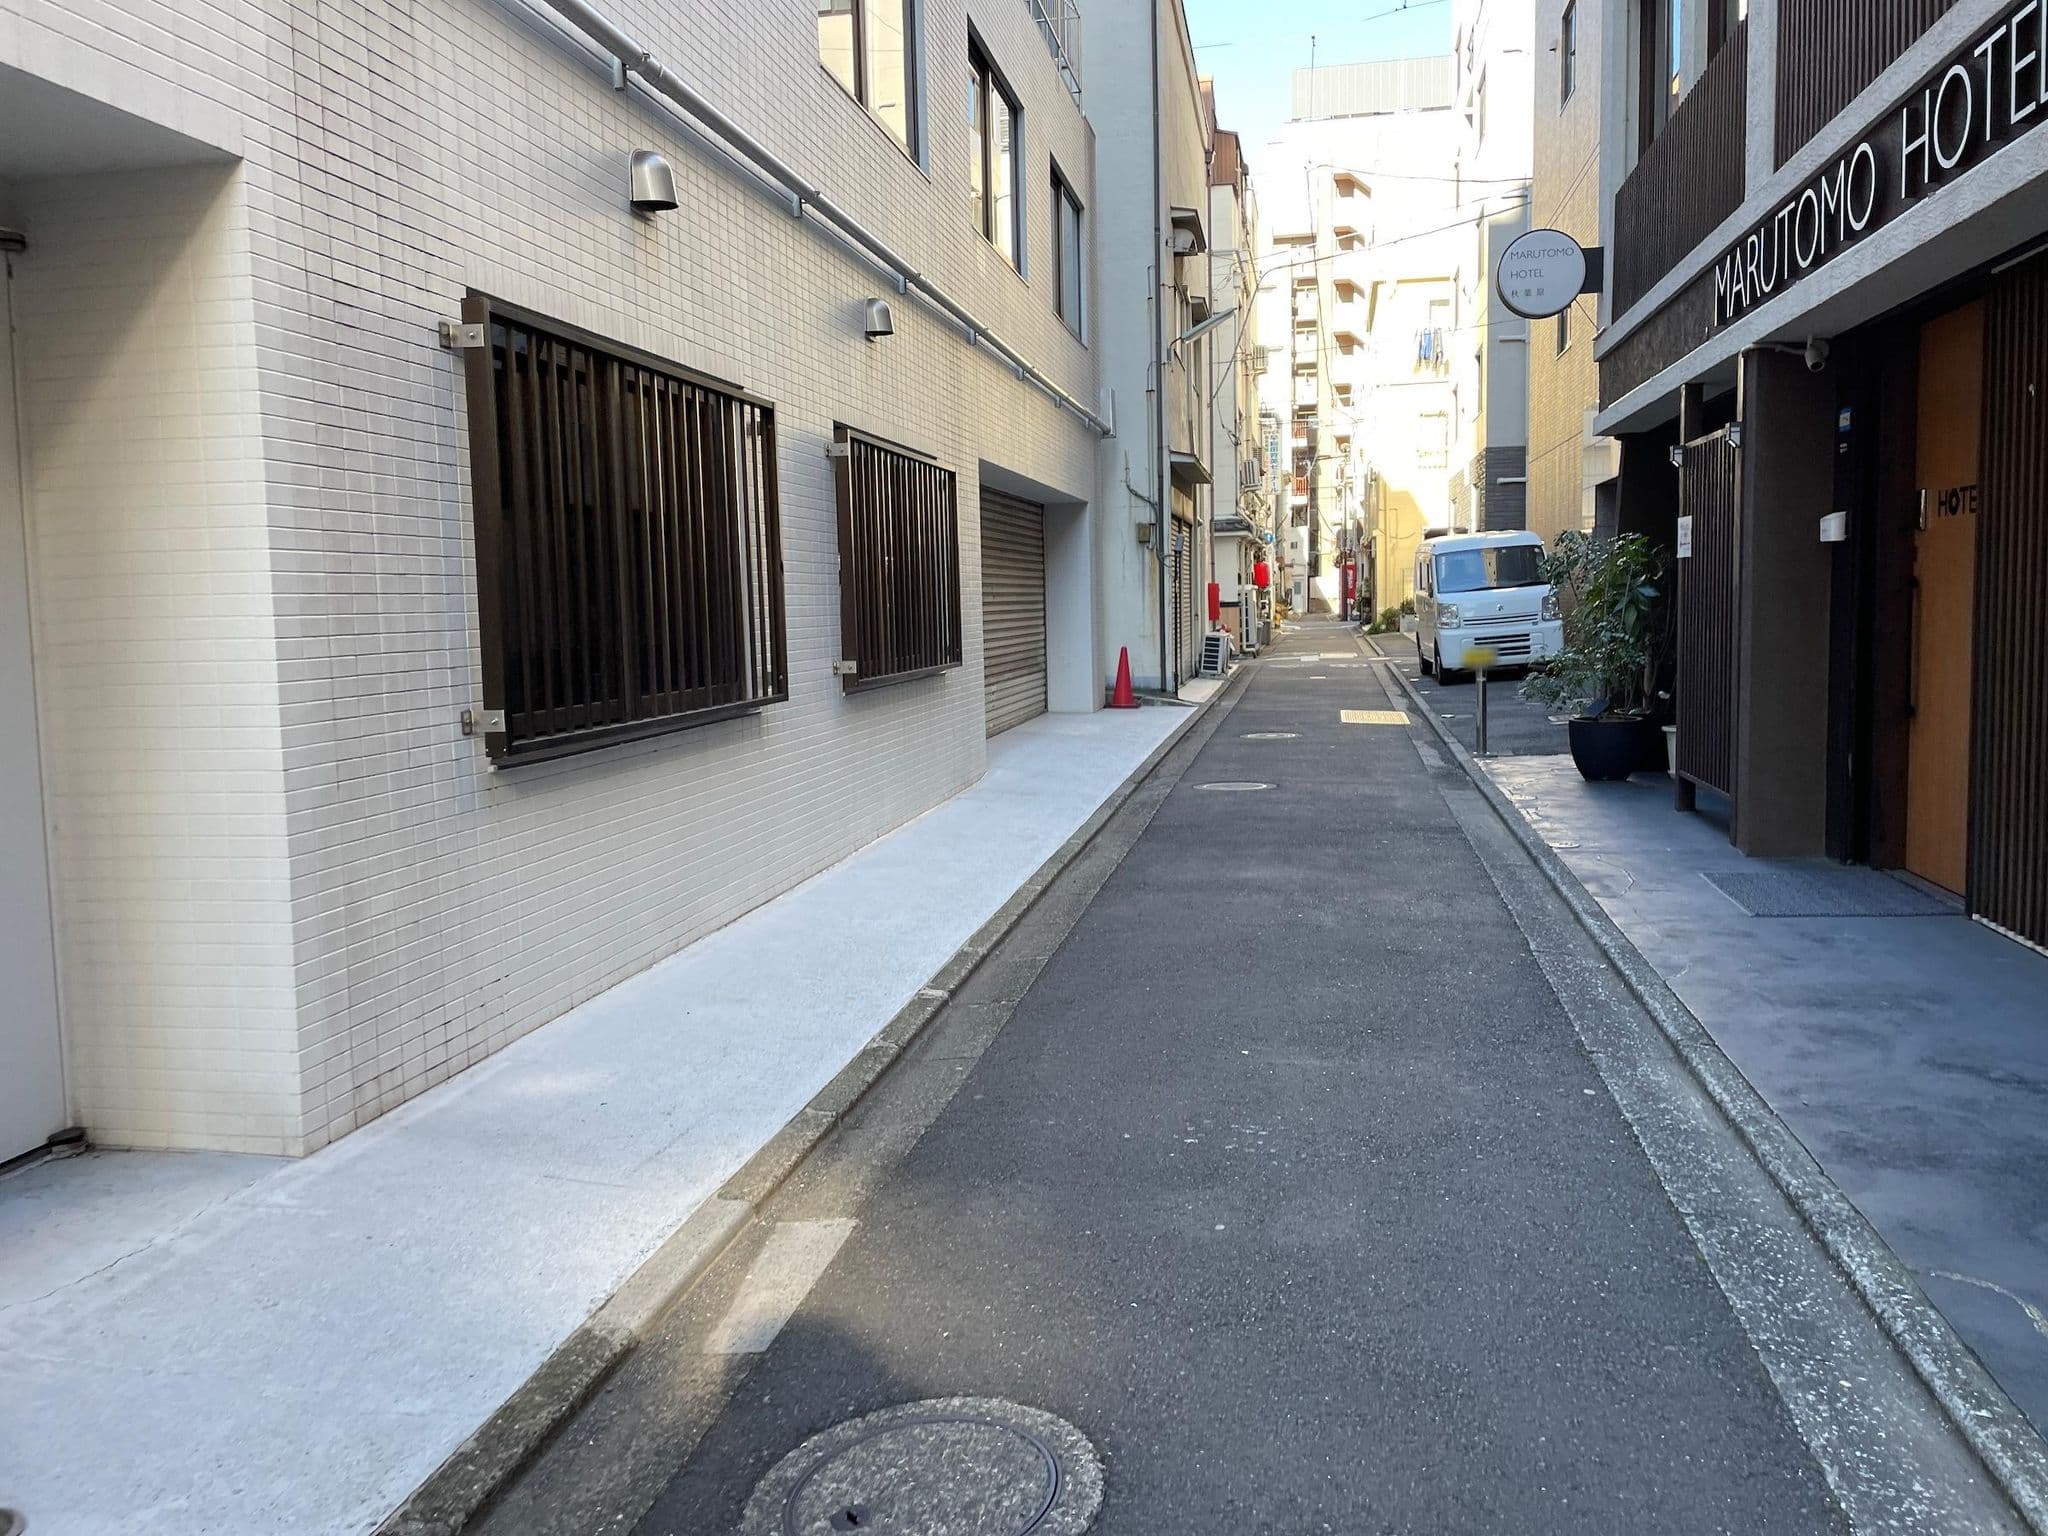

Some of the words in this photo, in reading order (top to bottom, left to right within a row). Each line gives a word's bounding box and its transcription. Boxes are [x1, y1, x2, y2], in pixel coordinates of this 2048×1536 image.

[1714, 142, 1875, 327] MARUTOMO
[1510, 247, 1575, 260] MARUTOMO
[1510, 268, 1544, 280] HOTEL
